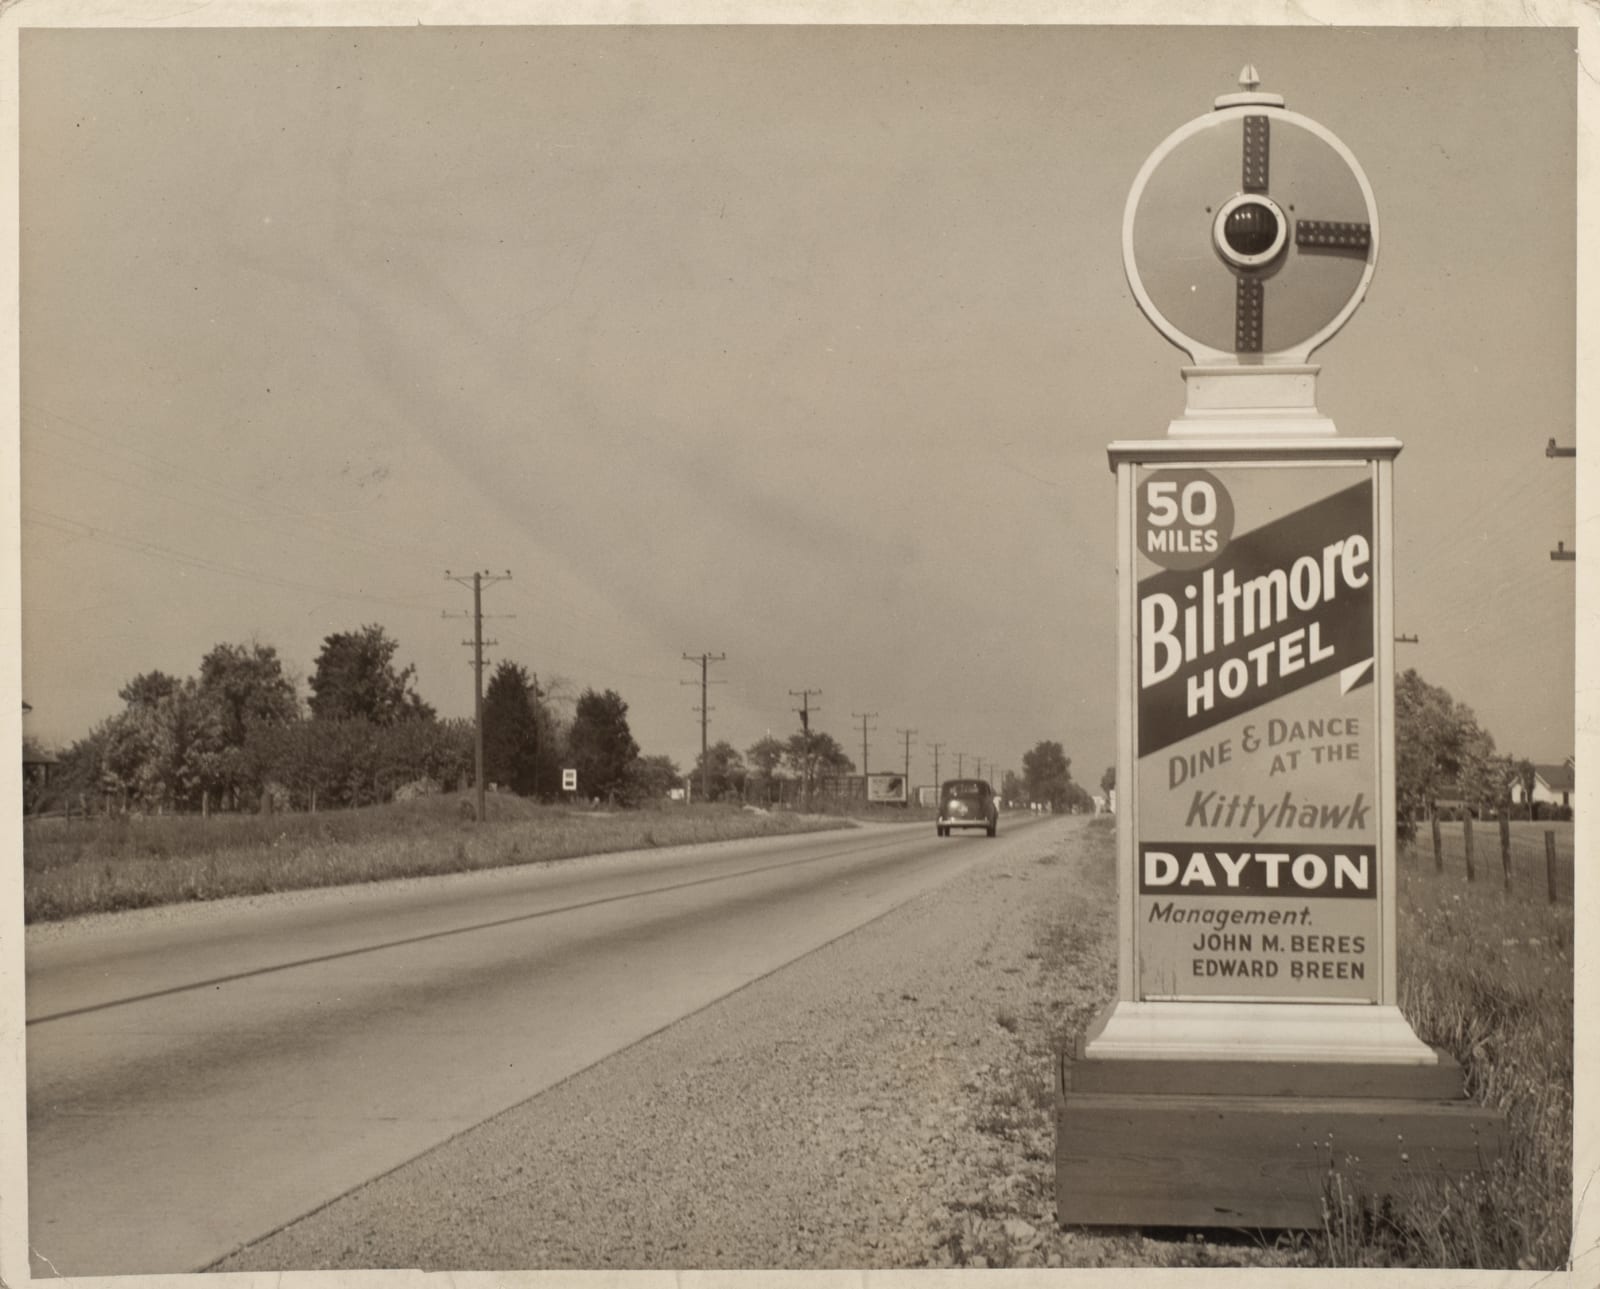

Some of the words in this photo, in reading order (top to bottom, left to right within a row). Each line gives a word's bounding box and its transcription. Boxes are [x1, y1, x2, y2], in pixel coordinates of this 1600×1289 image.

[1147, 480, 1217, 526] 50
[1147, 529, 1218, 552] MILES
[1141, 534, 1370, 689] Biltmore
[1187, 621, 1334, 718] HOTEL
[1169, 740, 1232, 790] DINE
[1242, 725, 1261, 753] &
[1268, 717, 1359, 746] DANCE
[1269, 751, 1301, 776] AT
[1311, 743, 1359, 764] THE
[1185, 791, 1371, 838] Kittyhawk
[1144, 851, 1368, 889] DAYTON
[1193, 933, 1251, 952] JOHN
[1262, 934, 1285, 953] M.
[1291, 935, 1365, 954] BERES
[1193, 958, 1278, 977] EDWARD
[1291, 961, 1365, 979] BREEN
